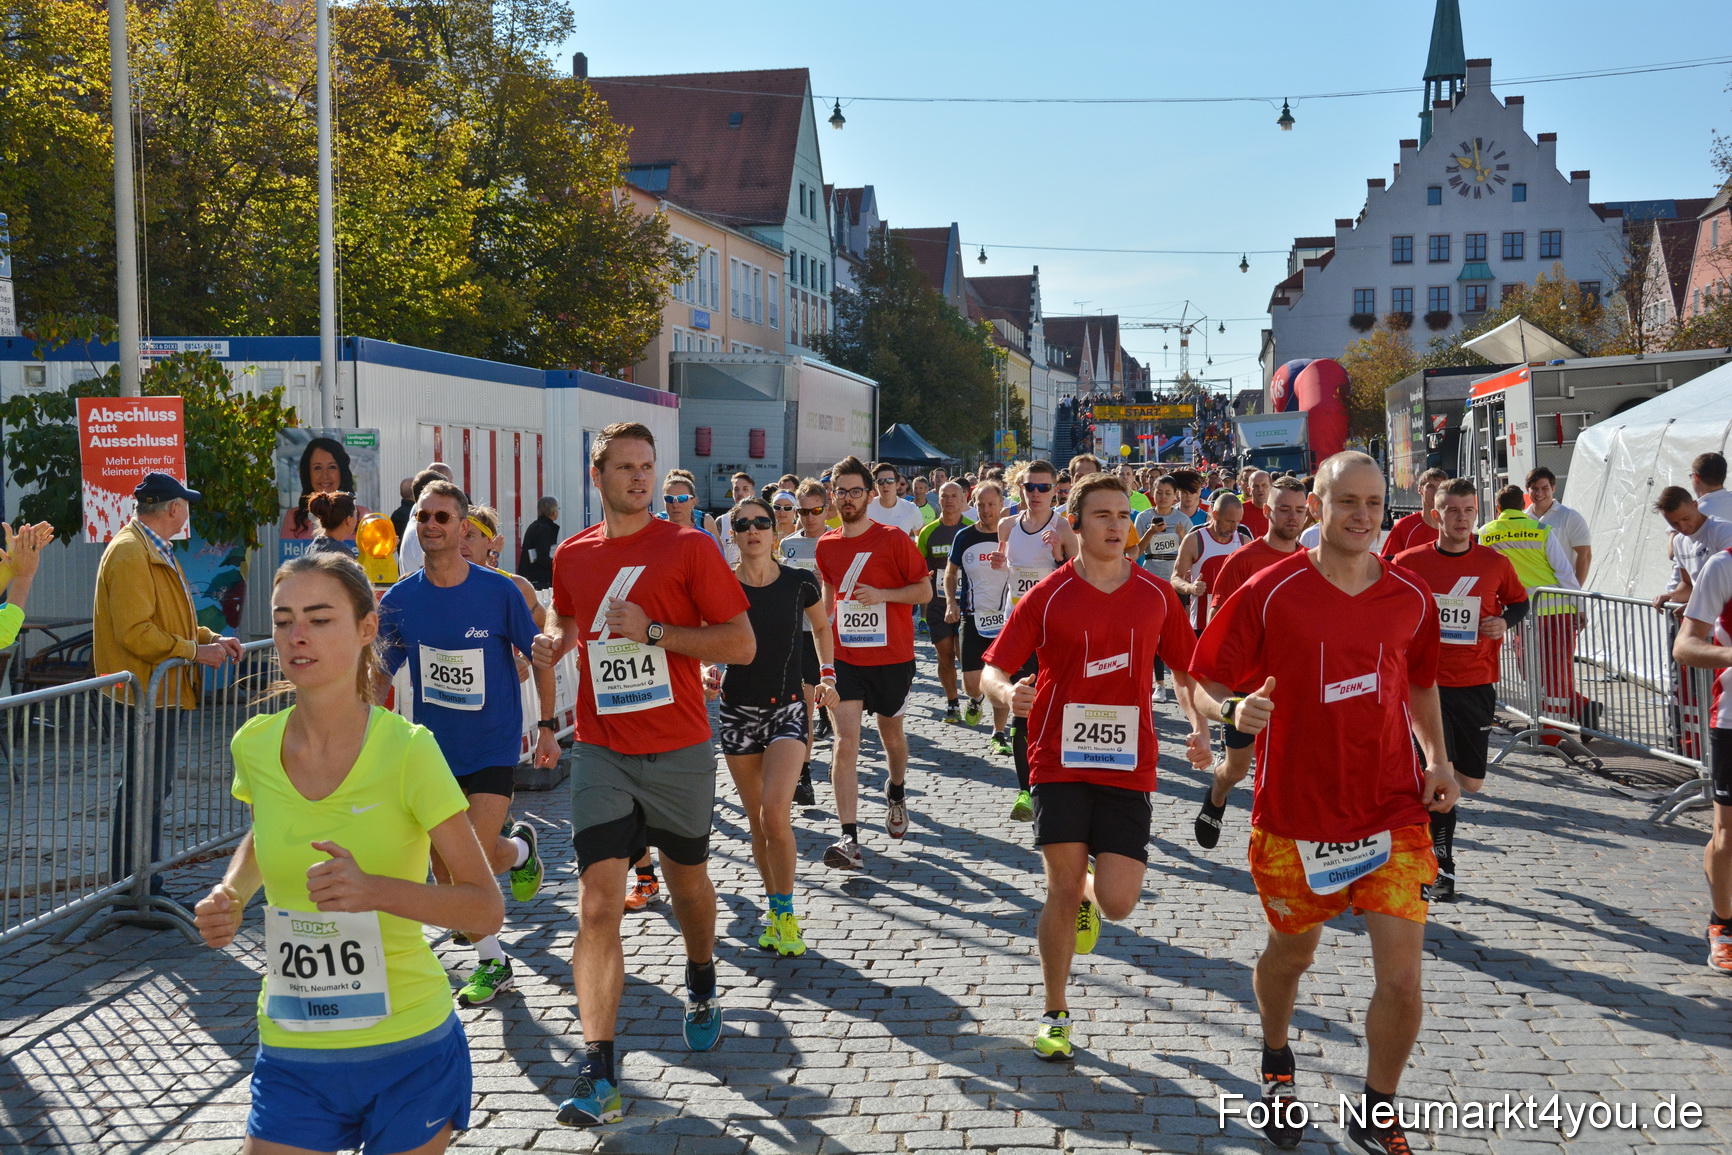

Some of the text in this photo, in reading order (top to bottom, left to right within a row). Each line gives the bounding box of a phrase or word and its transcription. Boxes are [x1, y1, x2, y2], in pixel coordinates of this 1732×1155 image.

[88, 407, 177, 422] Abschluss
[1126, 408, 1160, 417] START
[88, 424, 118, 433] statt
[89, 434, 178, 448] Ausschluss!
[105, 455, 175, 466] Mehr Lehrer für
[102, 467, 139, 476] kleinere
[1485, 531, 1539, 543] Org.-Leiter
[1154, 540, 1175, 551] 2506
[843, 612, 879, 627] 2620
[980, 614, 1004, 627] 2598
[1438, 607, 1471, 624] 619
[1440, 631, 1463, 639] orman
[606, 642, 641, 654] BOCK
[436, 653, 464, 662] BOCK
[600, 654, 656, 683] 2614
[1098, 660, 1118, 671] DEHN
[429, 662, 474, 685] 2635
[1339, 682, 1363, 695] DEHN
[438, 691, 467, 704] Thomas
[611, 691, 653, 705] Matthias
[1084, 710, 1117, 718] BOCK
[1073, 722, 1127, 745] 2455
[1084, 753, 1115, 763] Patrick
[1323, 852, 1369, 867] PARTL Neumarkt
[1328, 862, 1372, 883] Christian
[291, 919, 340, 935] BOCK
[279, 940, 365, 979] 2616
[311, 982, 349, 992] Neumarkt
[308, 1001, 339, 1017] Ines
